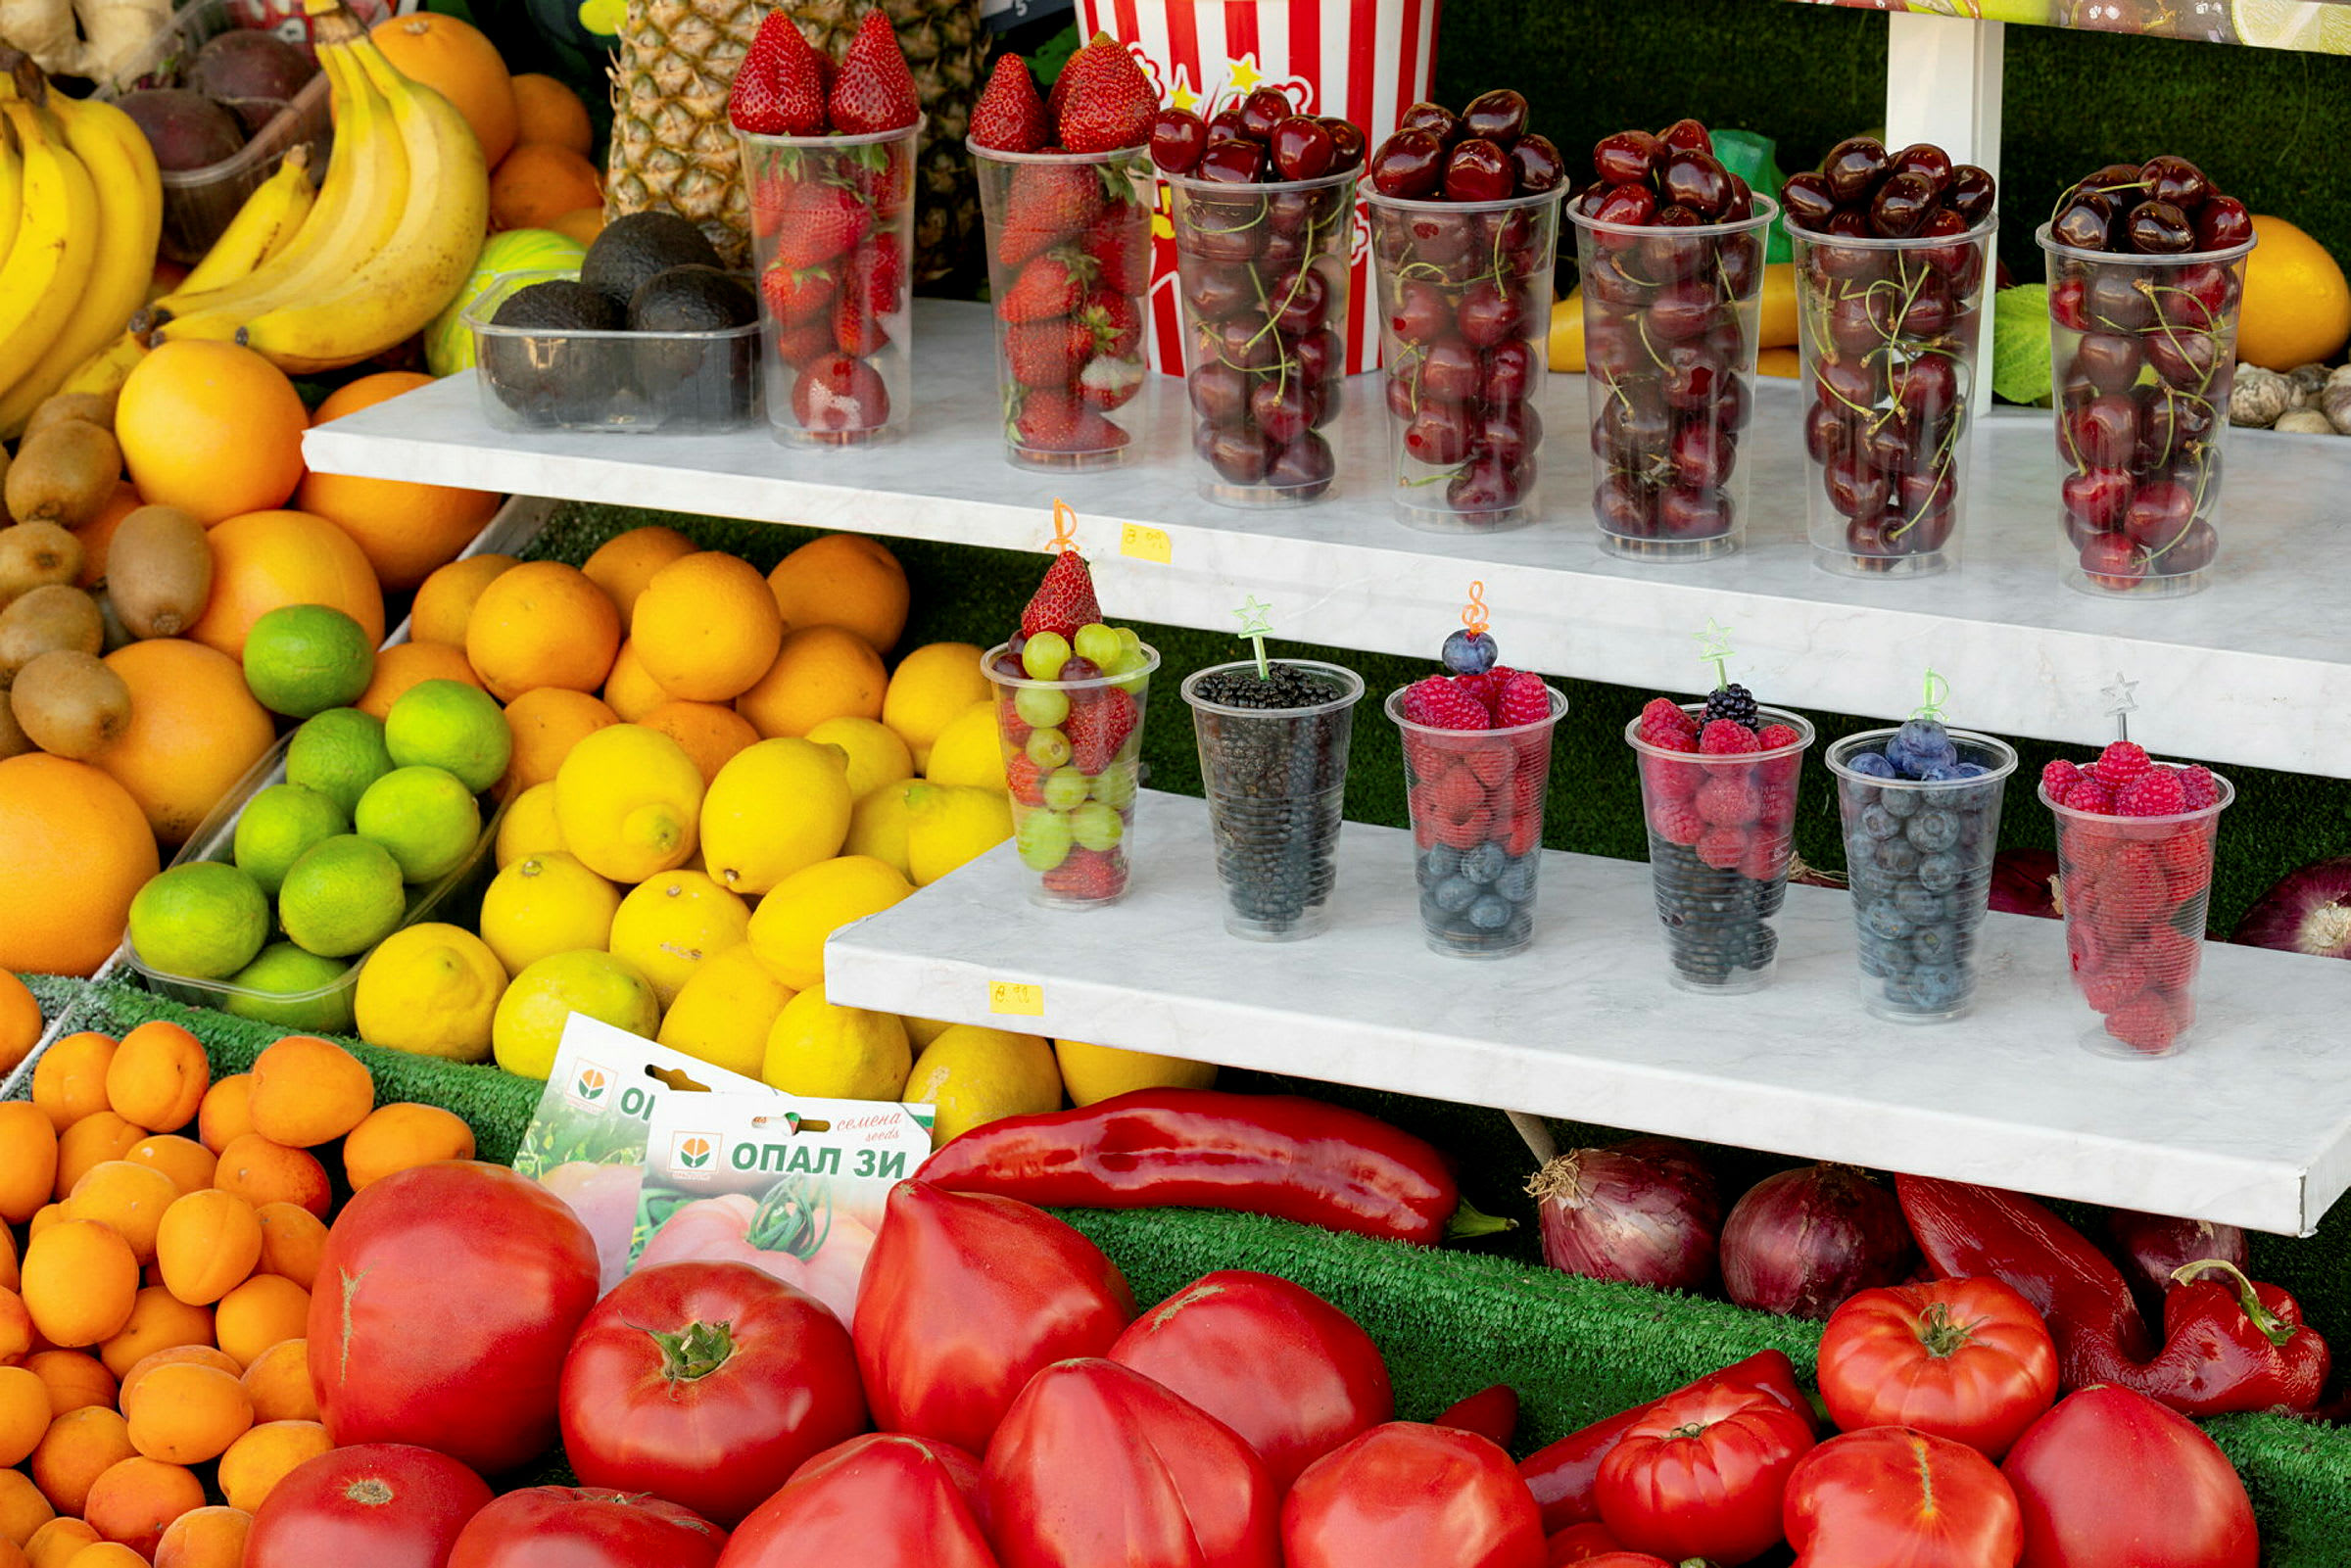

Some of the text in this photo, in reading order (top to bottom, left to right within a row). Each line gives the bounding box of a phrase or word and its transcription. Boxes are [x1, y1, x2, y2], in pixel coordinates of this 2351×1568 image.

[838, 1112, 901, 1131] семена
[864, 1127, 900, 1143] seeds
[732, 1142, 906, 1179] ОПАЛ ЗИ
